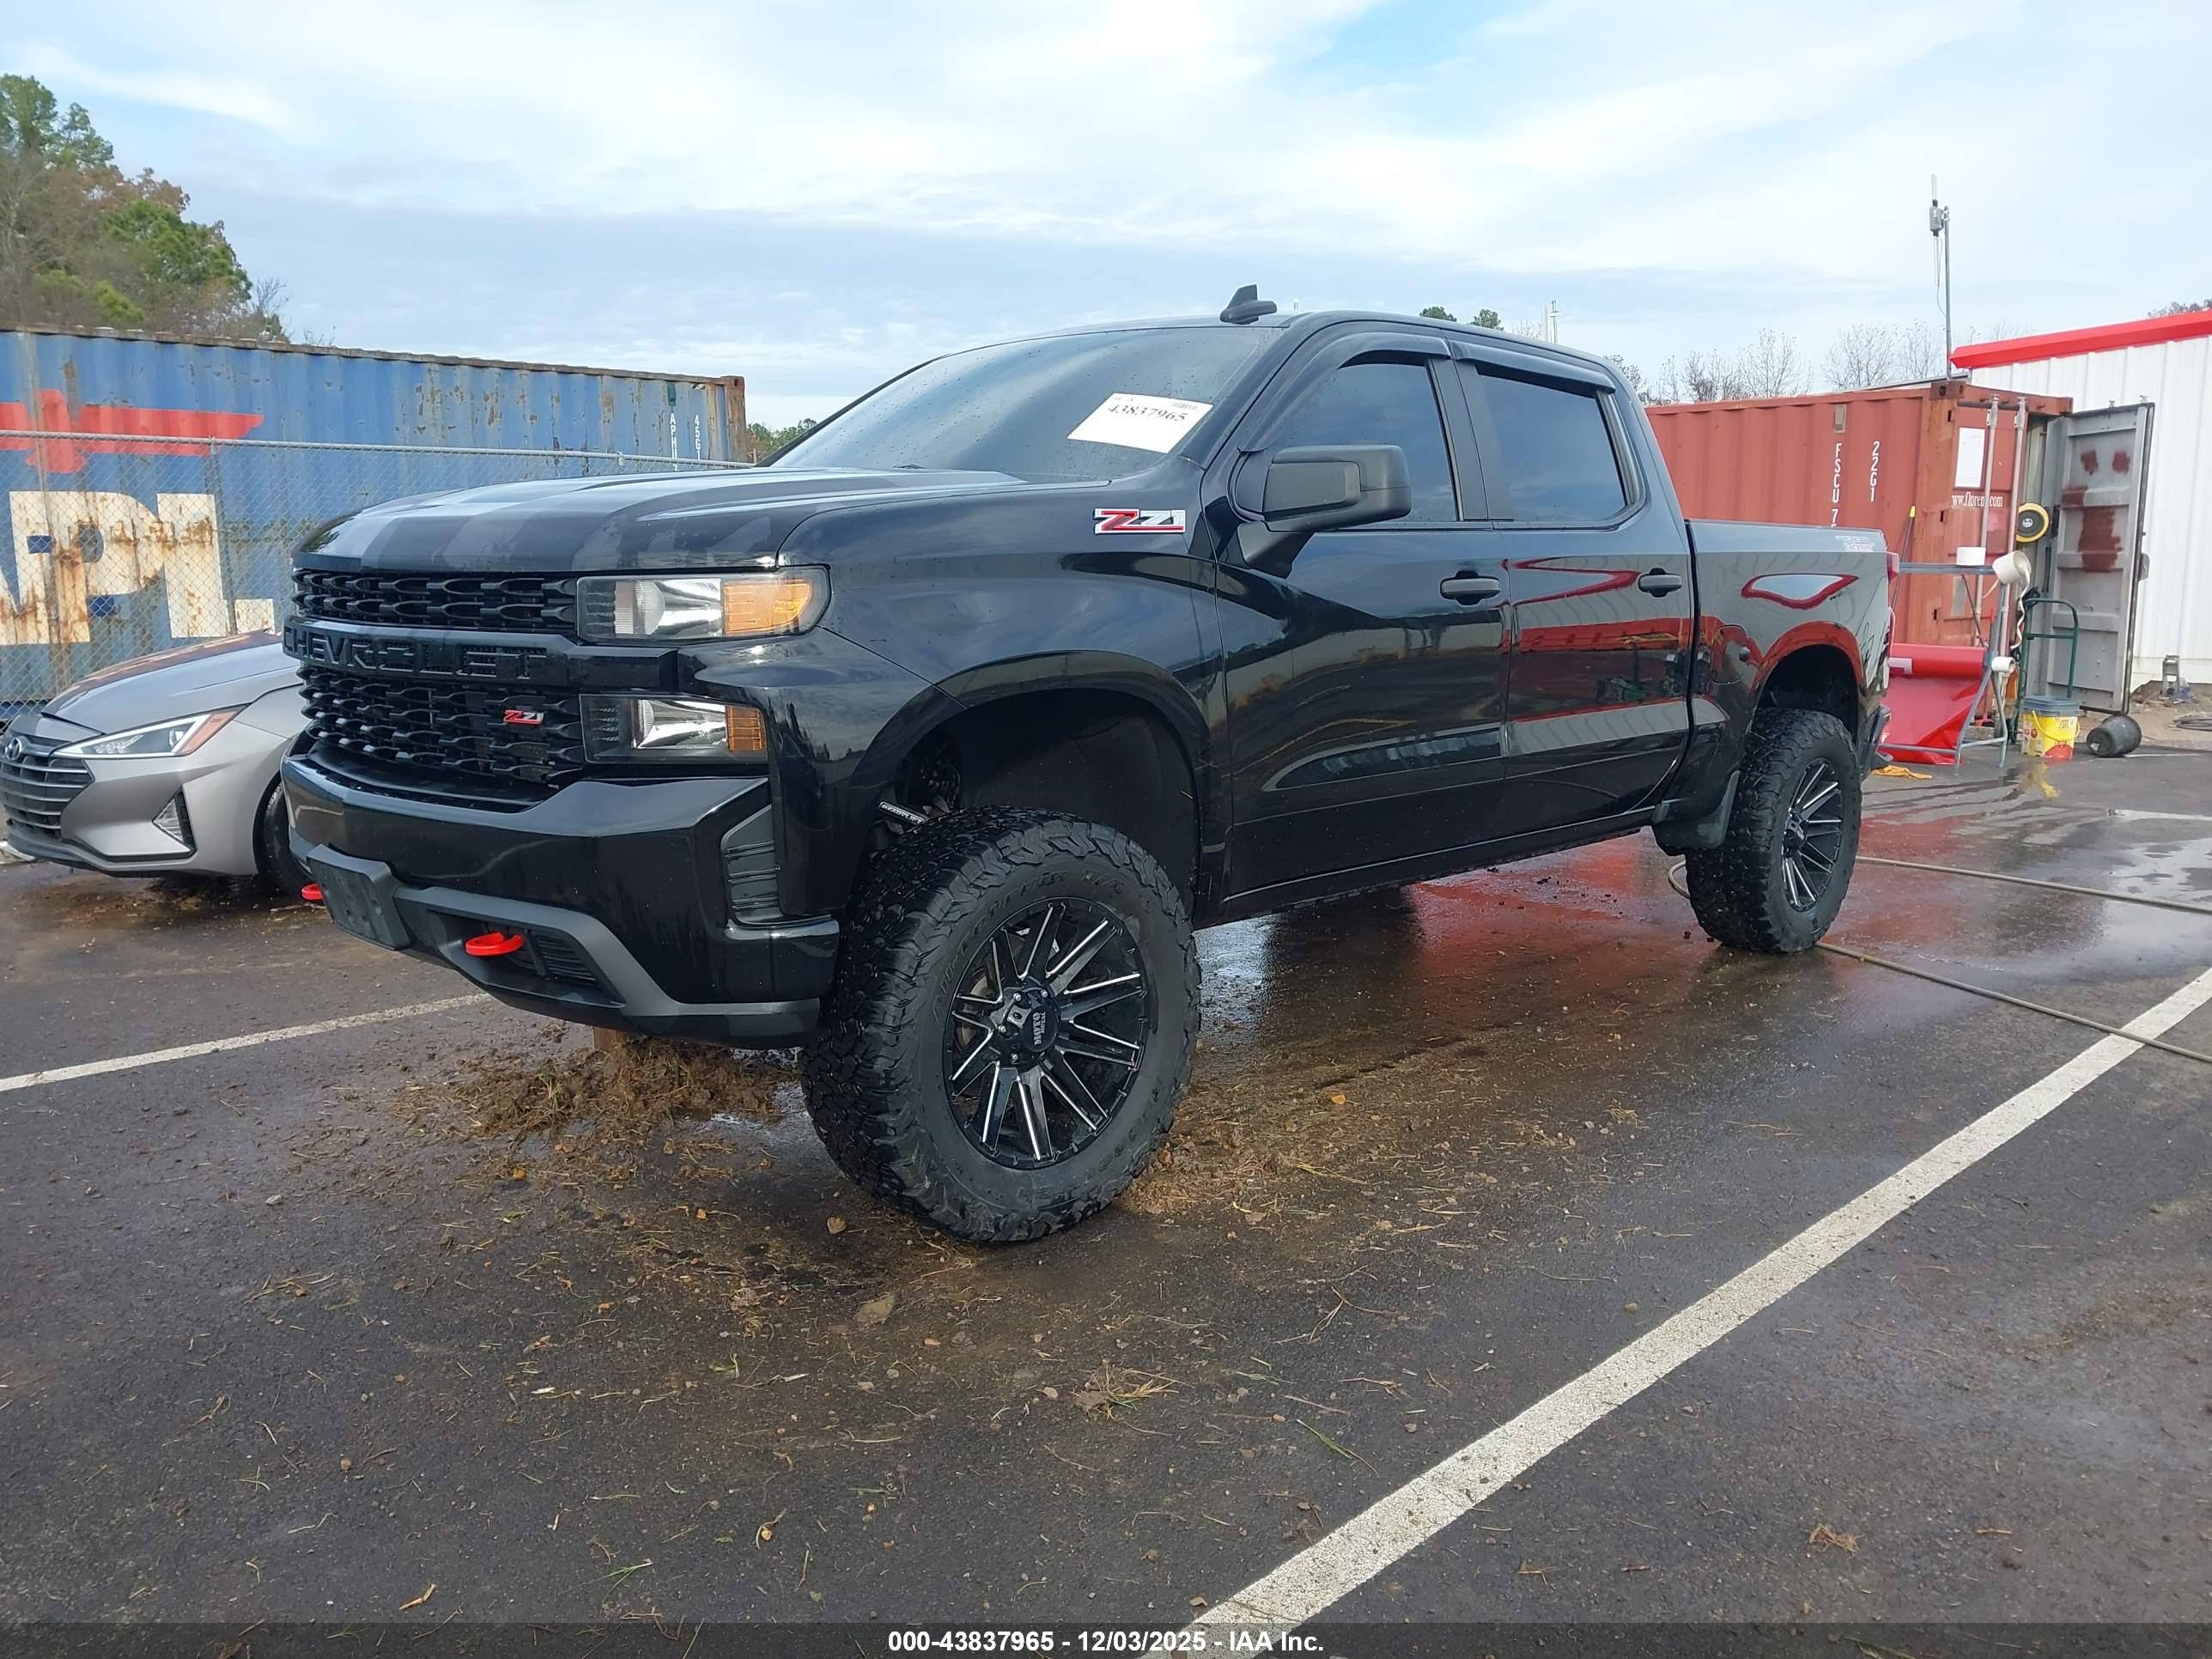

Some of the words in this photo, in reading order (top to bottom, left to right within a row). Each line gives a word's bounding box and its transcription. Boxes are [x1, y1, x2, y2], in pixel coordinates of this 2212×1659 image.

[1108, 404, 1189, 422] 43837965
[1832, 442, 1843, 503] FSCU
[1869, 441, 1881, 502] 22G1
[1094, 508, 1186, 534] Z71
[284, 625, 548, 679] CHEVROLET
[503, 709, 544, 724] Z71
